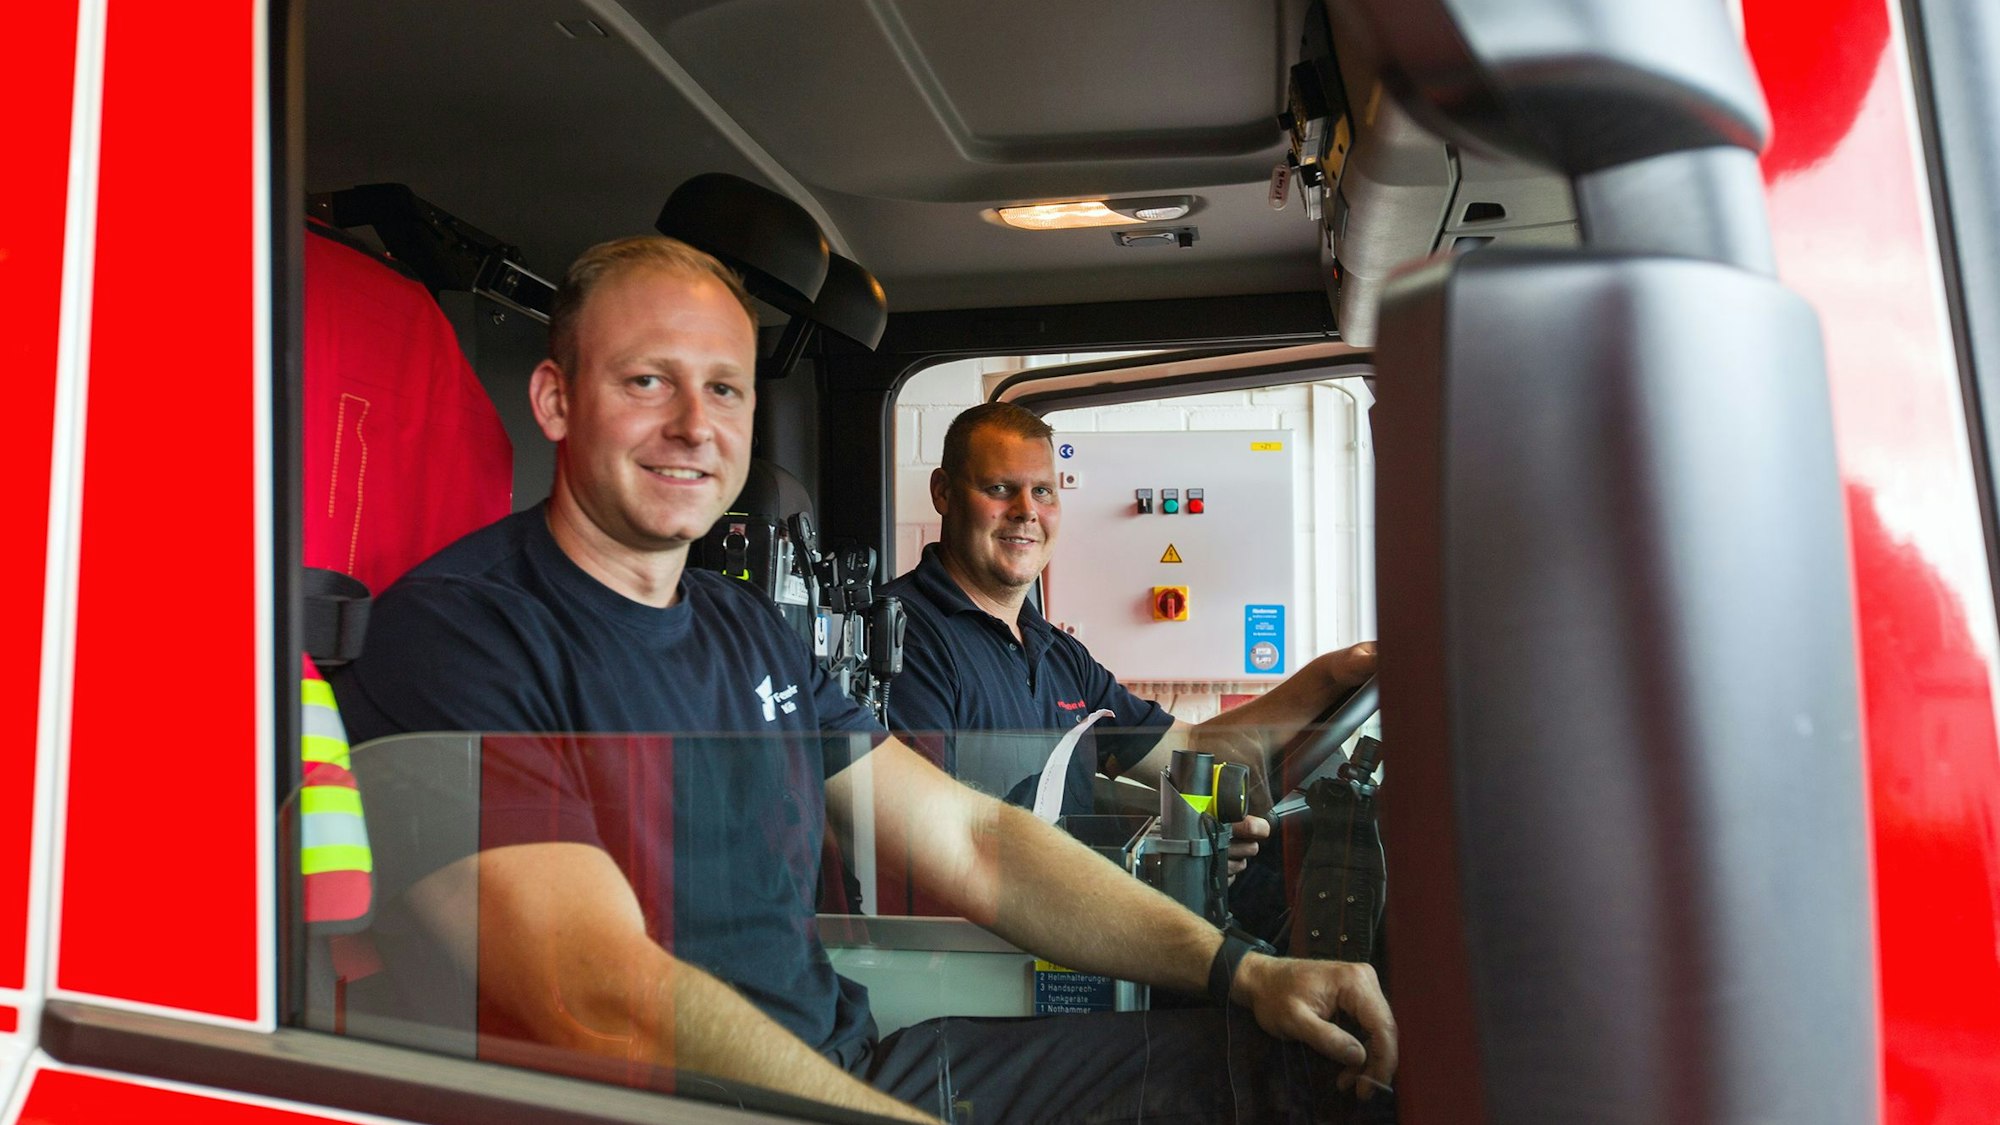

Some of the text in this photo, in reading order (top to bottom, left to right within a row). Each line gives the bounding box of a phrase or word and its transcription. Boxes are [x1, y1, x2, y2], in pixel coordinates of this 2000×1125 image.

[1060, 446, 1073, 456] CE
[1040, 973, 1045, 981] 2
[1040, 983, 1097, 994] 3 Handsprech-
[1047, 1004, 1092, 1014] Nothammer
